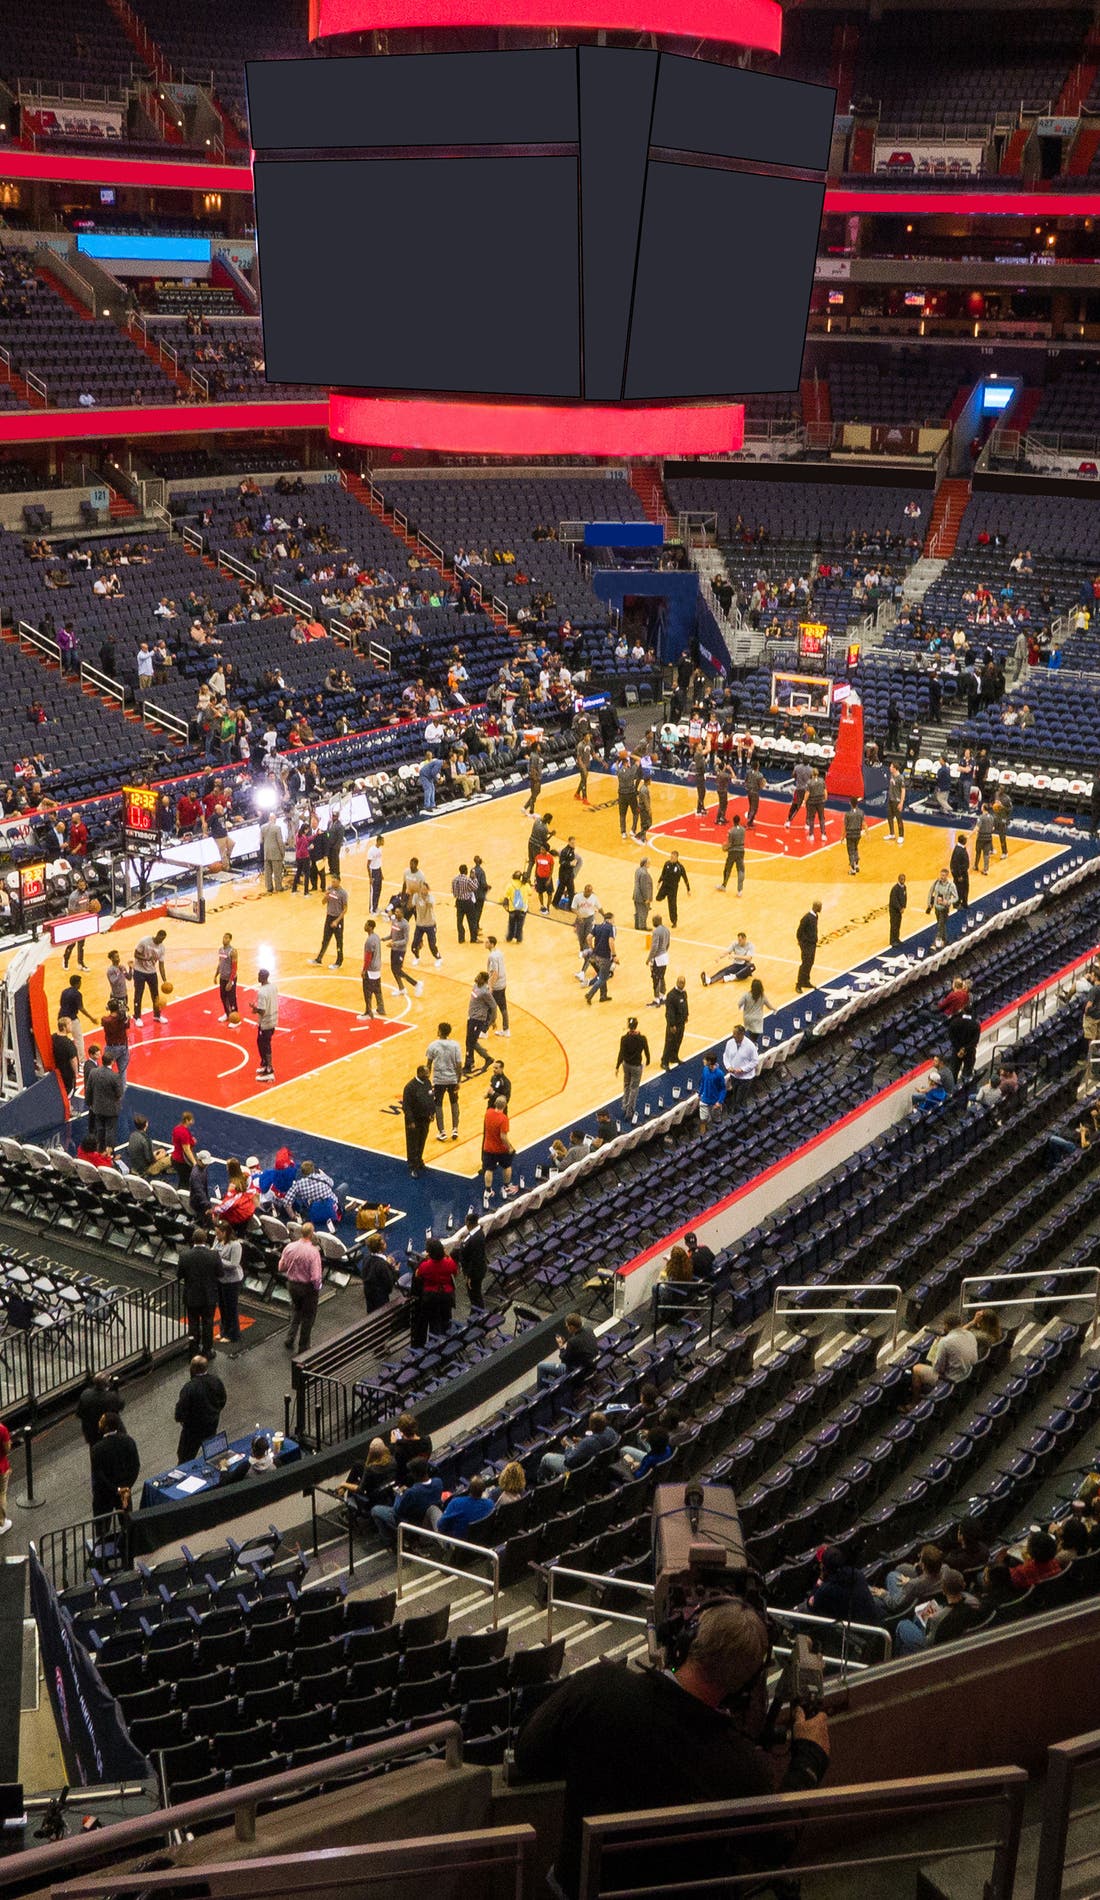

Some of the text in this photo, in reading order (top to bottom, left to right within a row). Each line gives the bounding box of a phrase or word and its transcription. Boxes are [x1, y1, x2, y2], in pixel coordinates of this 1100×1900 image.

[324, 474, 338, 484] 120
[610, 471, 624, 480] 119
[94, 490, 106, 501] 121
[131, 792, 155, 809] 12:32
[134, 829, 157, 841] TISSOT
